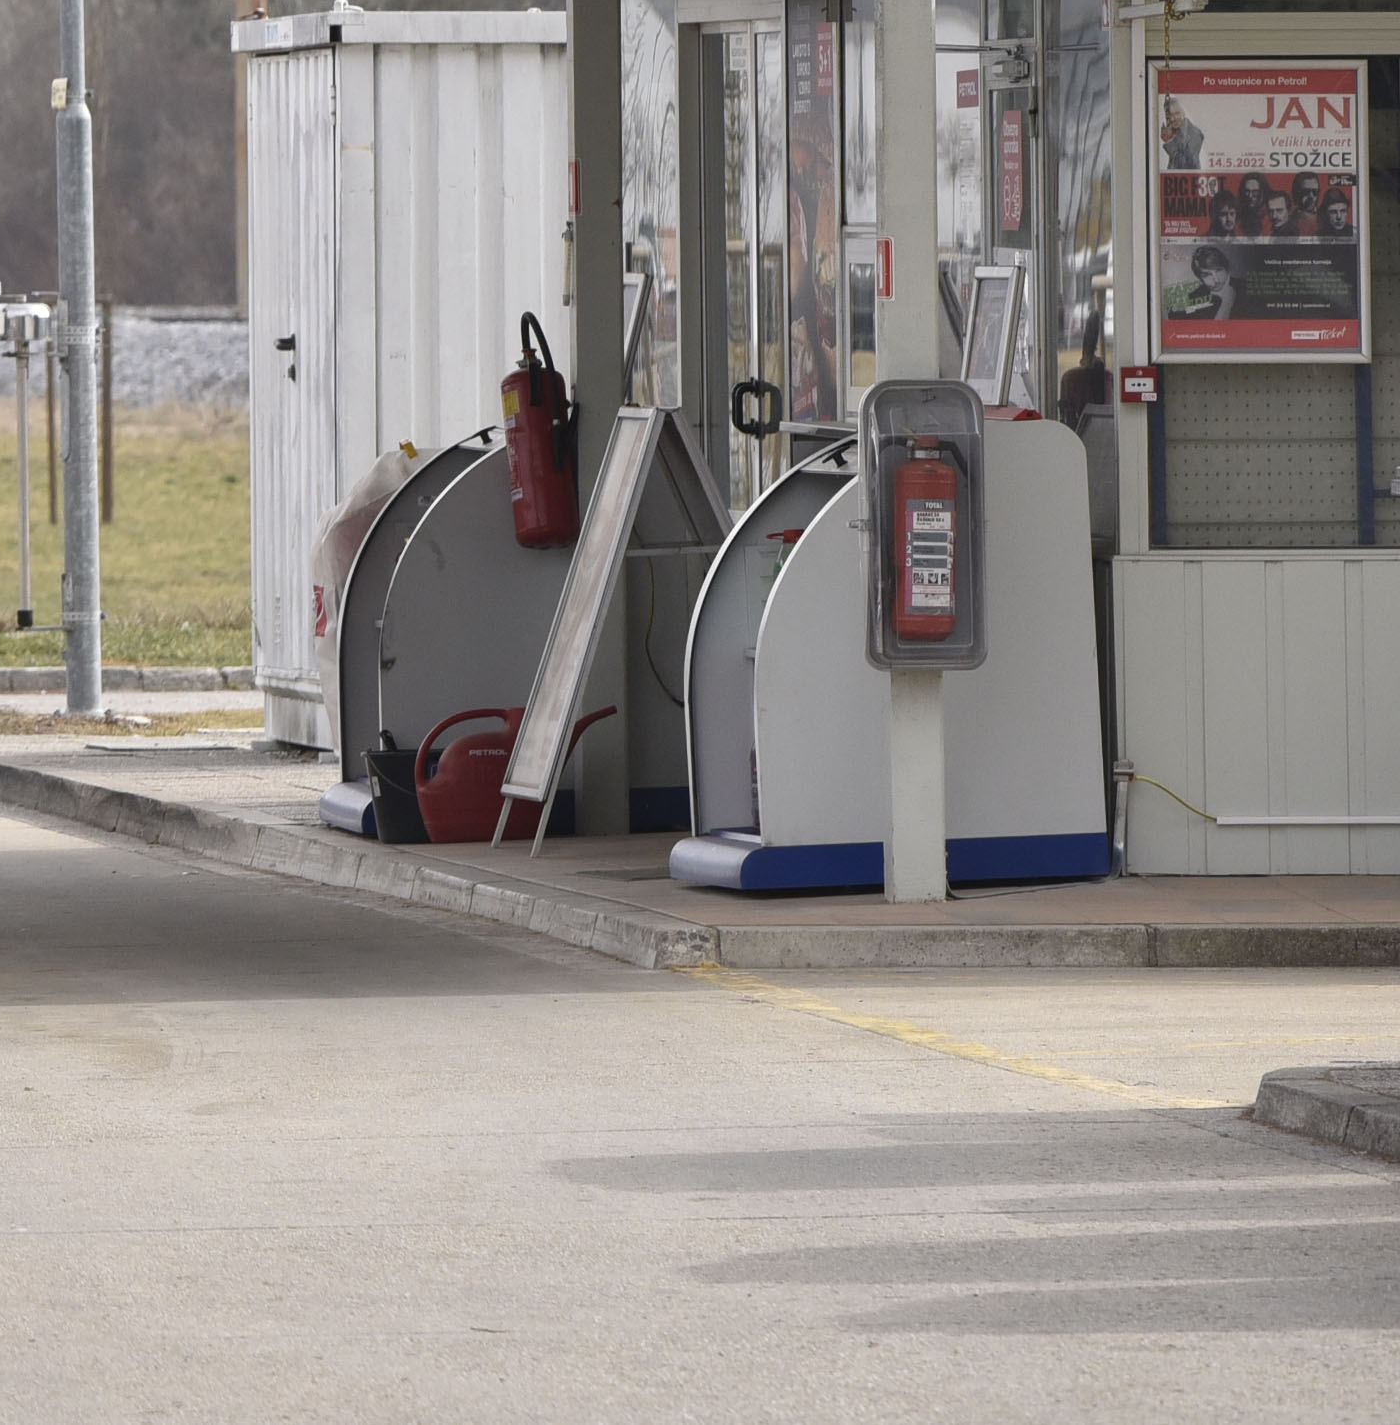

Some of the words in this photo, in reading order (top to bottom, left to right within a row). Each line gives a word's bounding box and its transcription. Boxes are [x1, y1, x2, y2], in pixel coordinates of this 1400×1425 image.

[1203, 77, 1216, 85] Po
[1218, 77, 1262, 87] vstopnice
[1278, 77, 1307, 86] Petrol!
[958, 81, 978, 97] PETROL
[1250, 96, 1351, 129] JAN
[1270, 136, 1304, 147] Veliki
[1307, 136, 1352, 147] koncert
[1208, 157, 1265, 168] 14.5.2022
[1269, 149, 1352, 168] STOŽICE
[1165, 177, 1190, 197] BIG
[1165, 198, 1207, 218] MAMA
[907, 532, 911, 540] 1
[905, 545, 912, 554] 2
[905, 558, 912, 567] 3
[469, 748, 507, 756] PETROL
